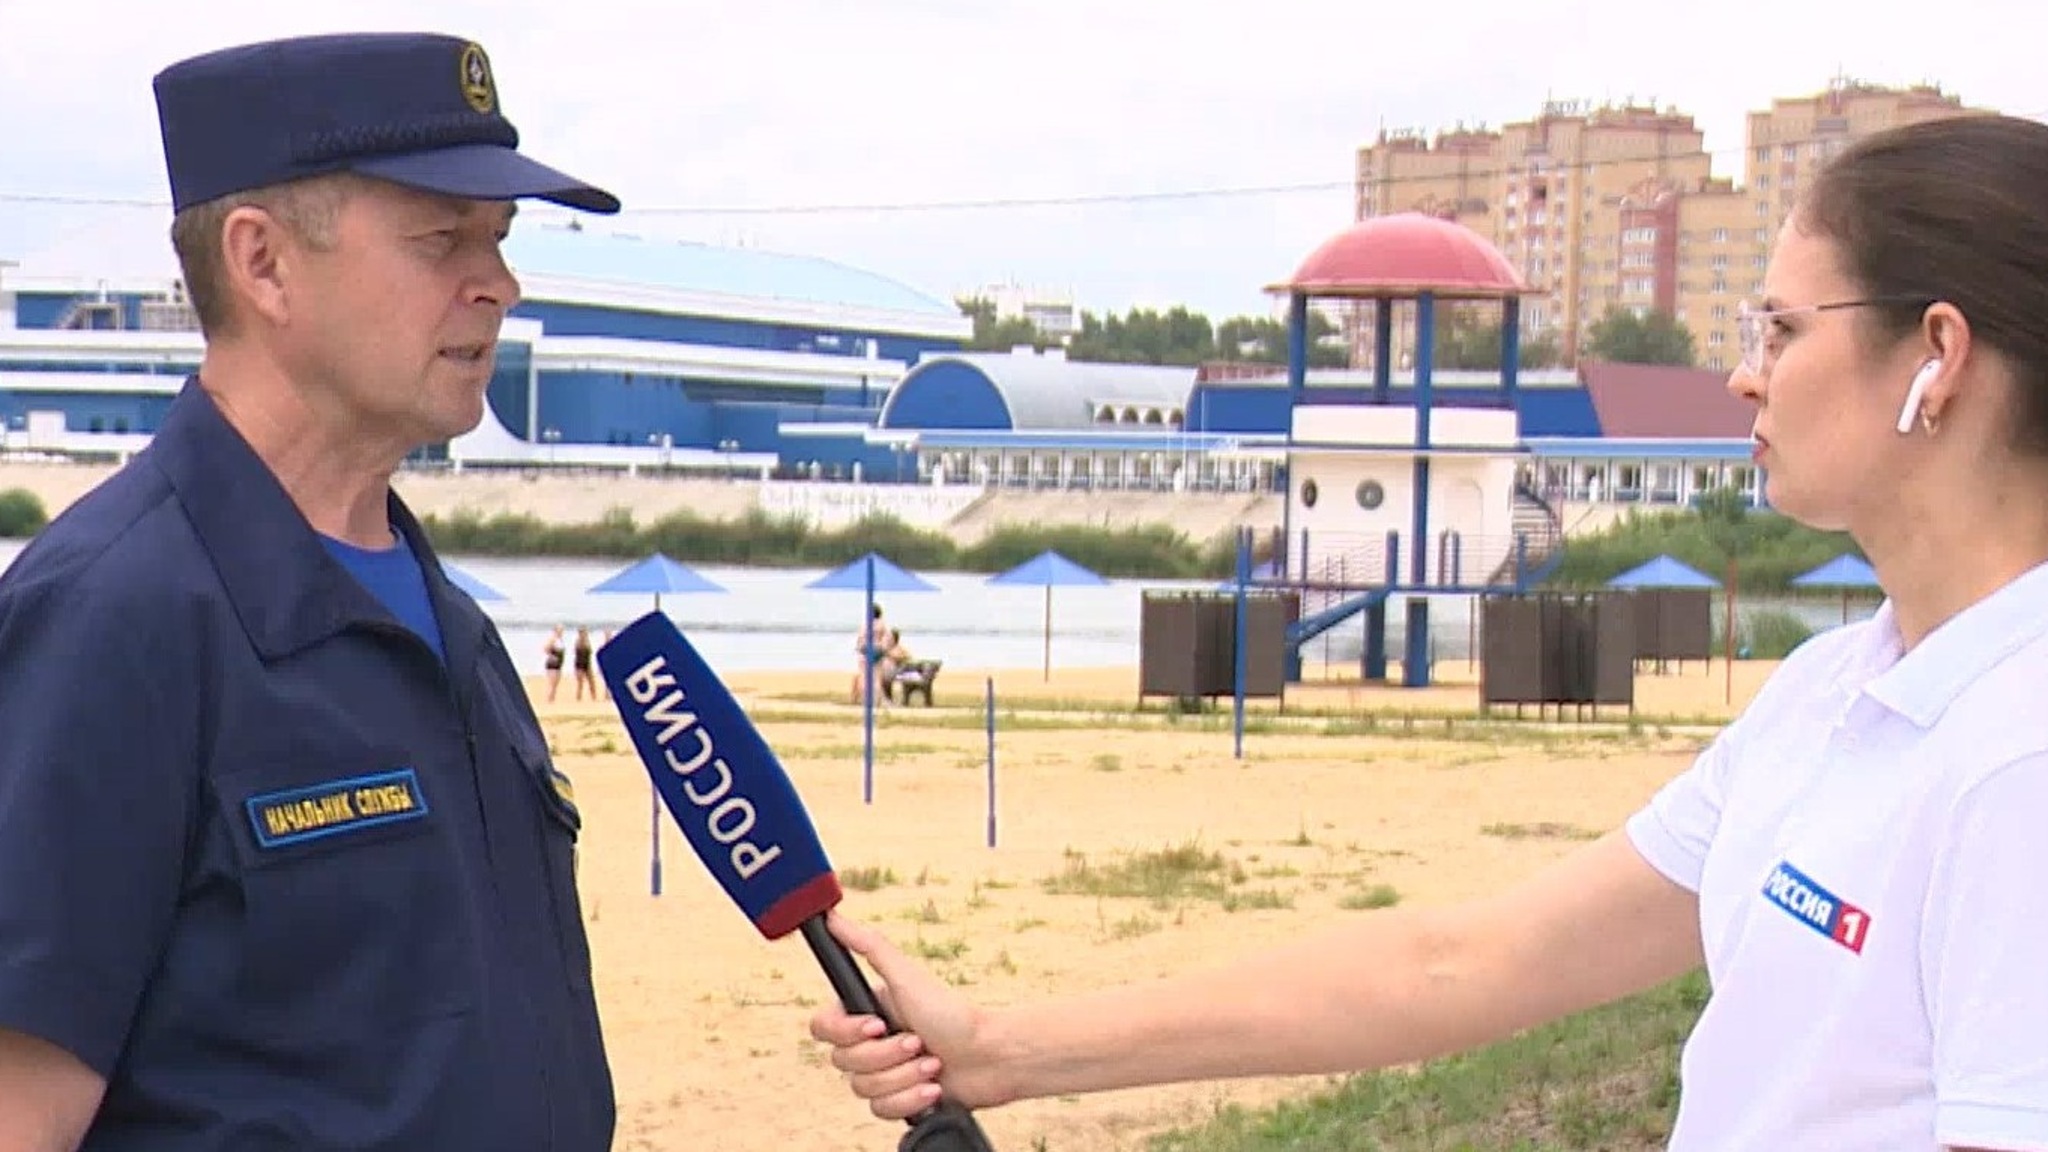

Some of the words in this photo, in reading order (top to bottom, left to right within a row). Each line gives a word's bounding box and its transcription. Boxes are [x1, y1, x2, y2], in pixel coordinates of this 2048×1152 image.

[625, 656, 781, 879] РОССИЯ
[265, 792, 353, 835] НАЧАЛЬНИК
[355, 784, 413, 816] СЛУЖБЫ
[1842, 912, 1861, 944] 1
